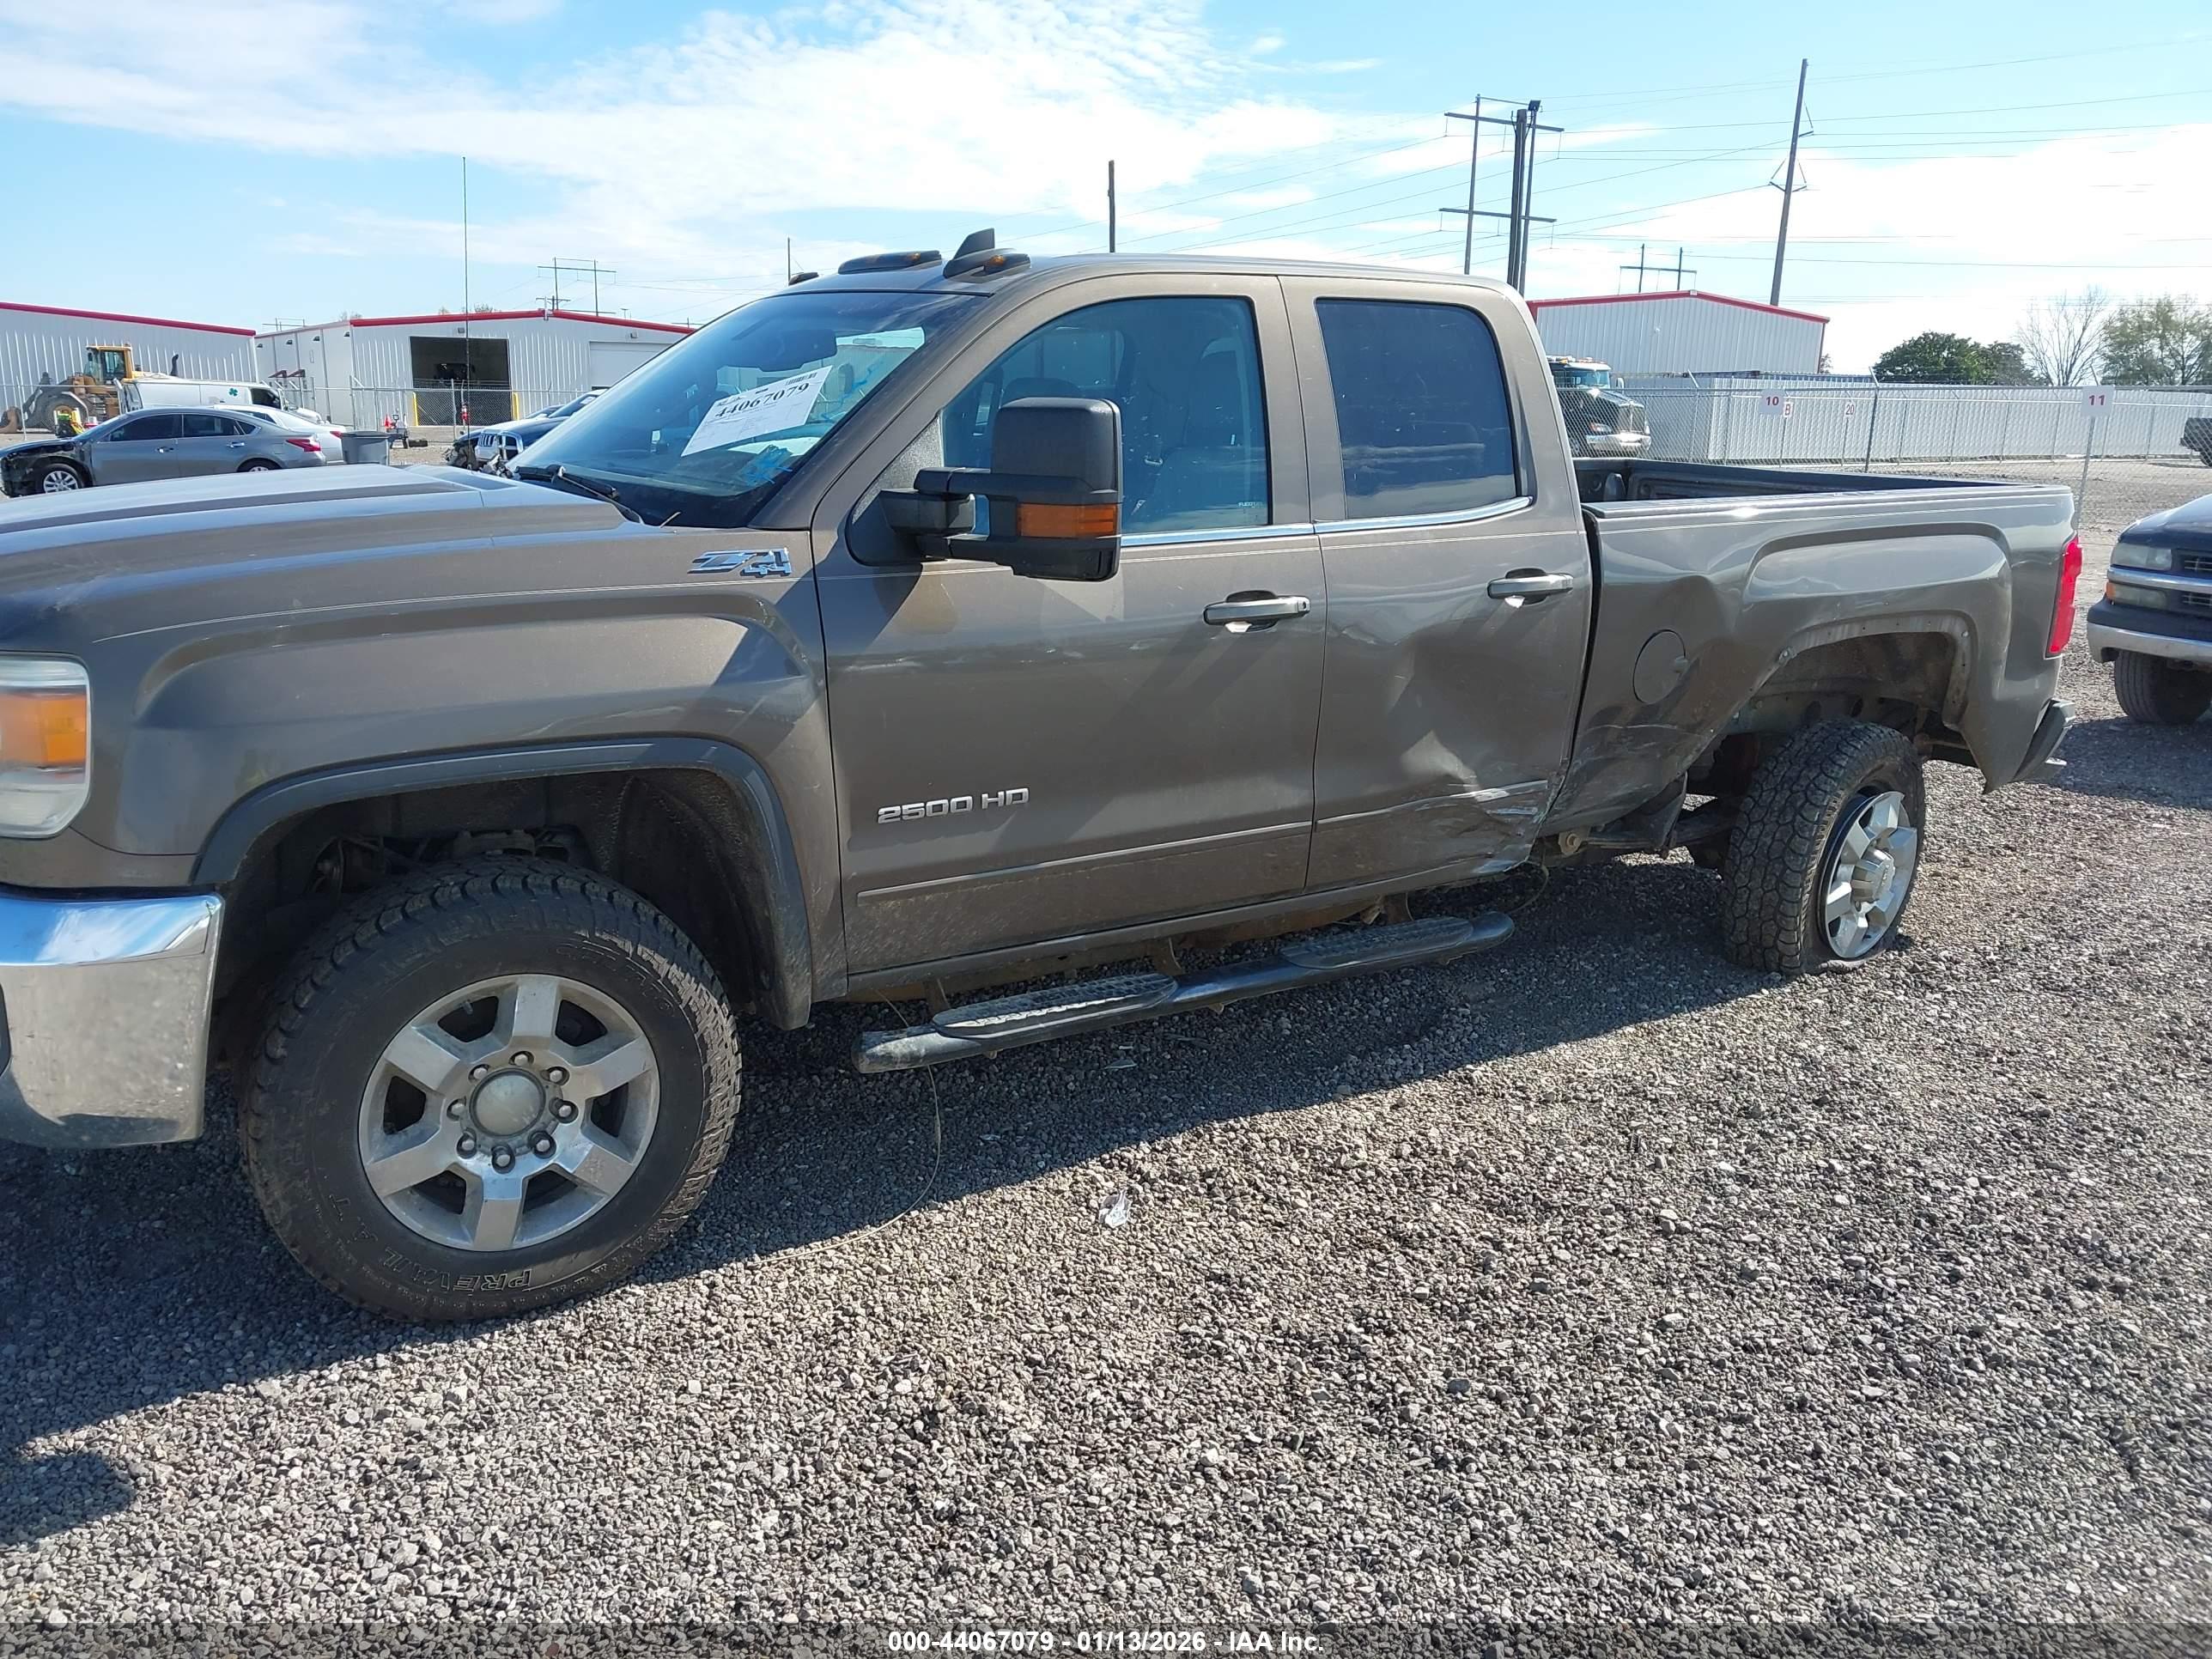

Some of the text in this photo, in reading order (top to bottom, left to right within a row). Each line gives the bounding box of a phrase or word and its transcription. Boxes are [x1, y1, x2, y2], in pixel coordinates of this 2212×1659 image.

[715, 382, 810, 417] 44067079
[1765, 396, 1779, 405] 10
[2088, 395, 2106, 406] 11
[1845, 404, 1855, 415] 20
[877, 787, 1030, 824] 2500 HD
